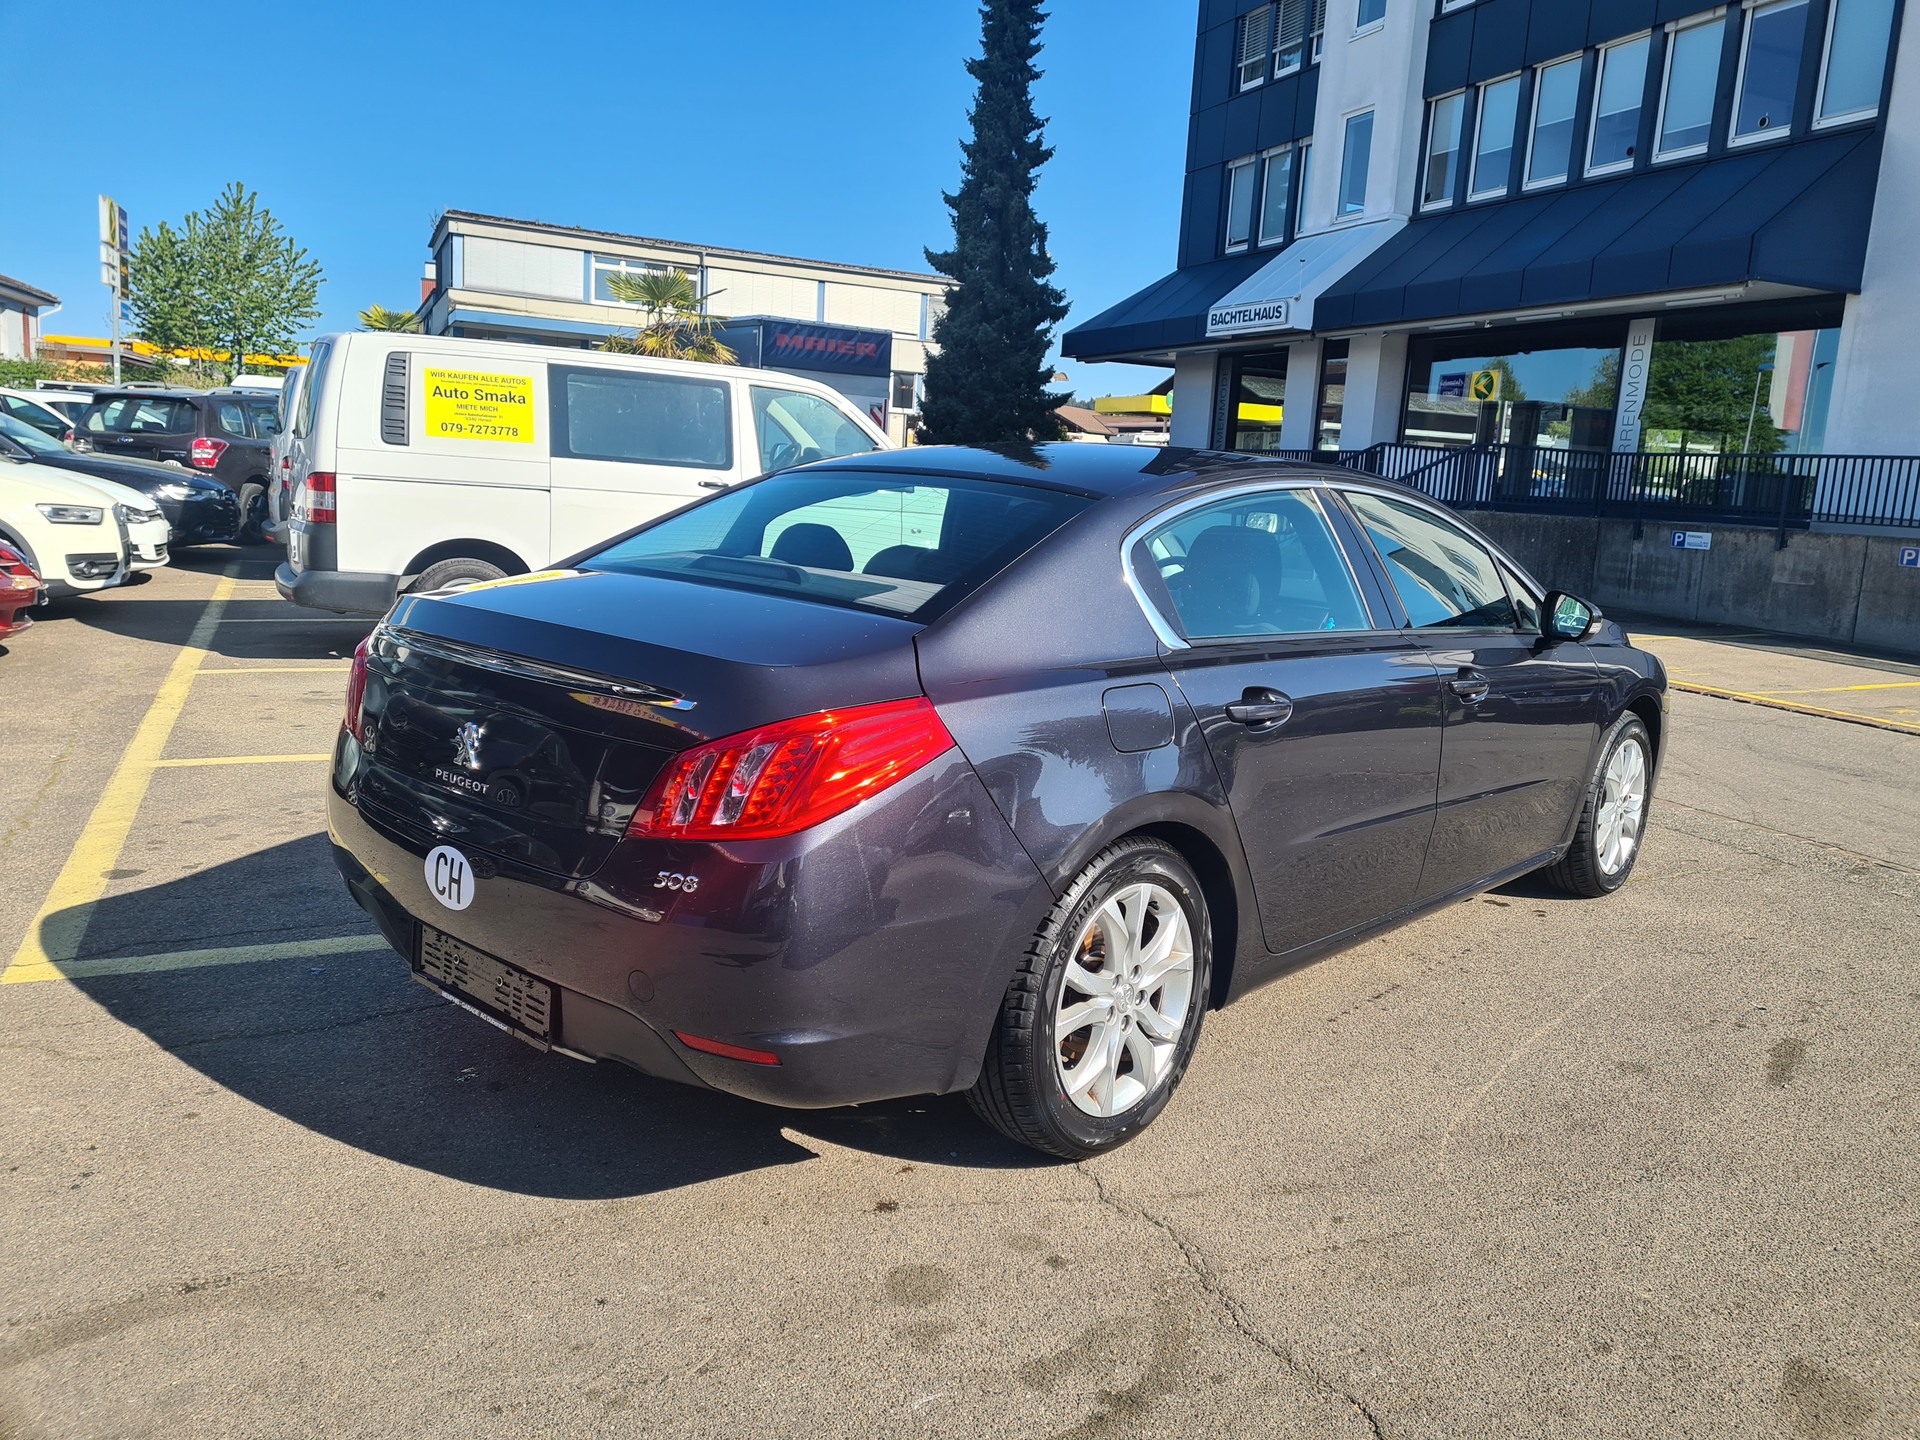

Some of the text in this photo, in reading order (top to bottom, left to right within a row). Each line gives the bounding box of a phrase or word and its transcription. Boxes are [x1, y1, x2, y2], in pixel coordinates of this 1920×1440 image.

[1210, 305, 1283, 327] BACHTELHAUS
[776, 333, 878, 357] MAIER
[447, 372, 479, 381] KAUFEN
[481, 375, 500, 383] ALLE
[501, 377, 527, 386] AUTOS
[432, 385, 526, 405] Auto Smaka
[456, 403, 478, 411] MIETE
[1215, 369, 1230, 450] AMENMODE
[440, 422, 519, 437] 079-7273778
[1674, 533, 1684, 546] P
[1902, 549, 1916, 565] P
[435, 768, 490, 794] PEUGEOT
[435, 852, 464, 905] CH
[653, 870, 699, 893] 508
[1053, 894, 1099, 970] YOKOHAMA
